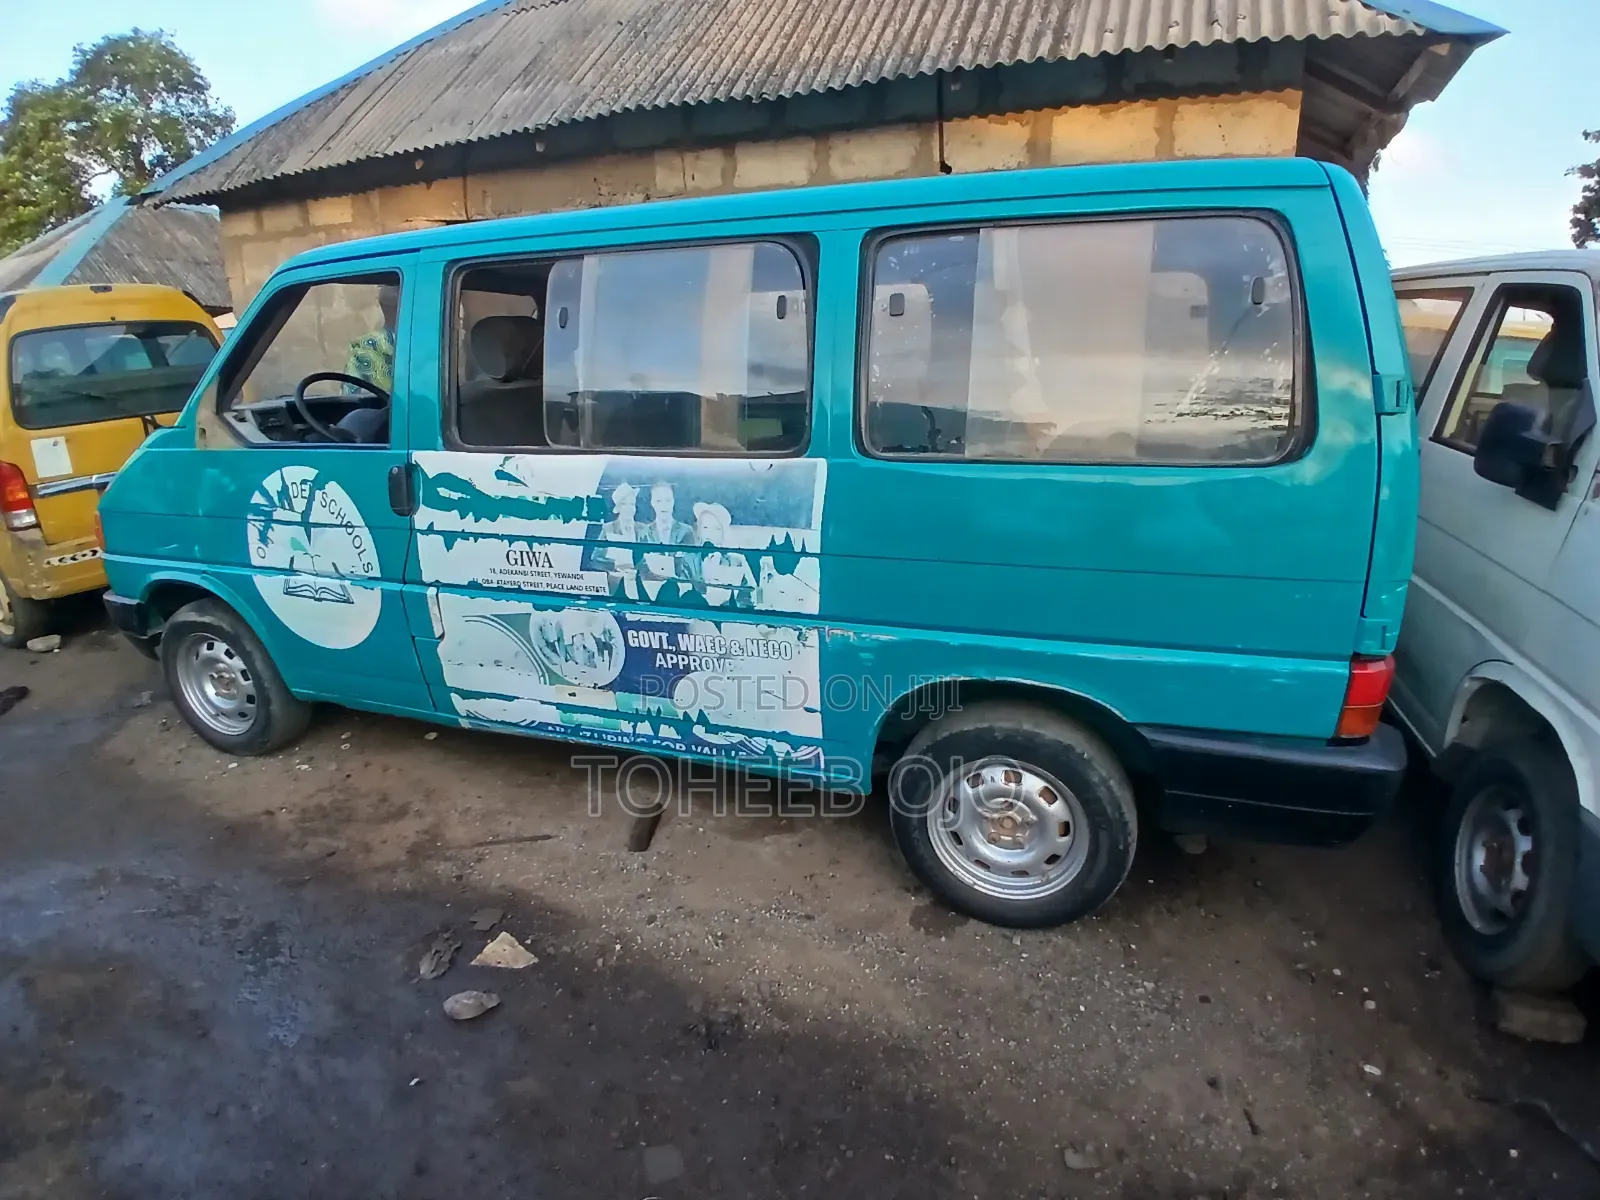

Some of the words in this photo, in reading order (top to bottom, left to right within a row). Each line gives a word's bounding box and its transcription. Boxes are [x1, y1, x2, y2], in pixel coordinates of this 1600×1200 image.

[319, 491, 374, 574] SCHOOLS
[505, 549, 554, 568] GIWA
[677, 633, 726, 655] WAEC
[730, 639, 745, 657] &
[745, 638, 792, 661] NECO
